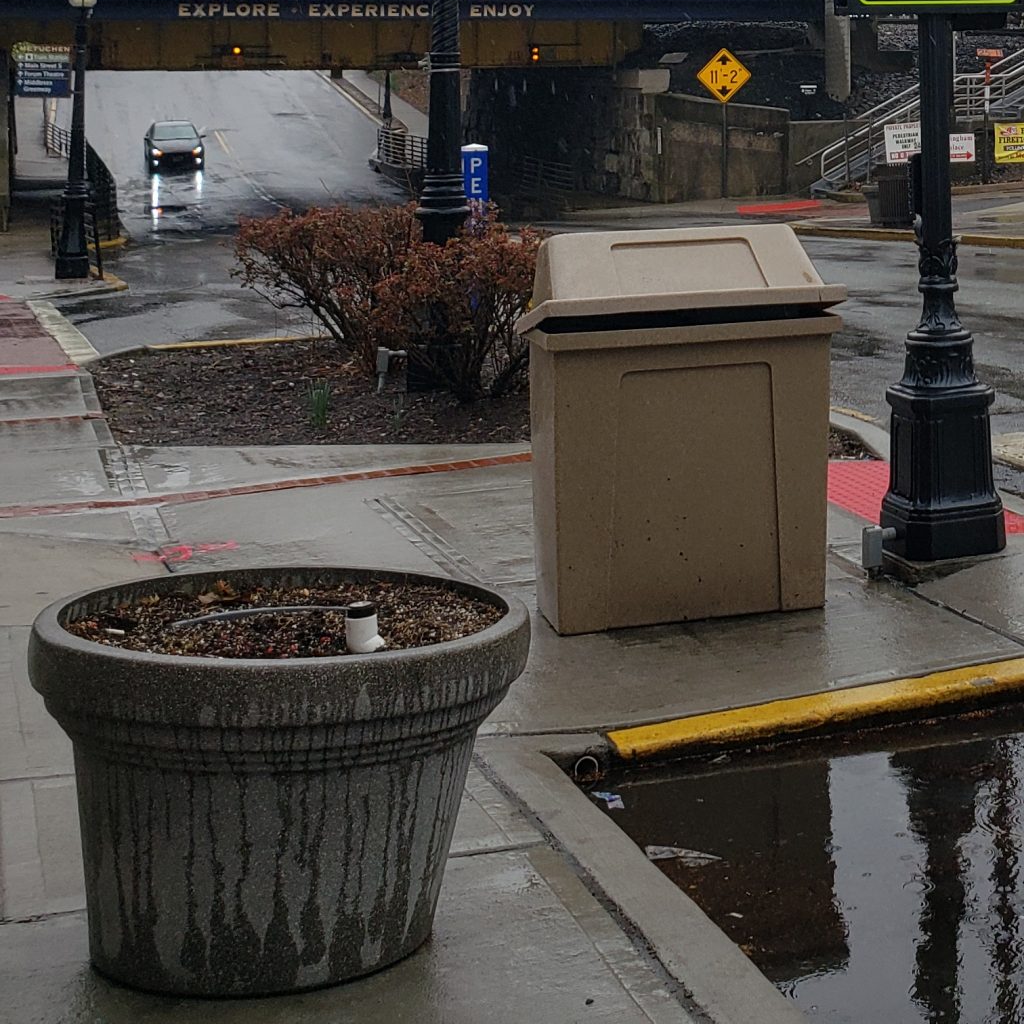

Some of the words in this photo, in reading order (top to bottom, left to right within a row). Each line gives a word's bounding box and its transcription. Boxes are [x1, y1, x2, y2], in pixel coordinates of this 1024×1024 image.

[178, 3, 280, 18] EXPLORE
[308, 3, 434, 18] EXPERIENC
[470, 4, 535, 18] ENJOY
[18, 45, 71, 53] METUCHEN
